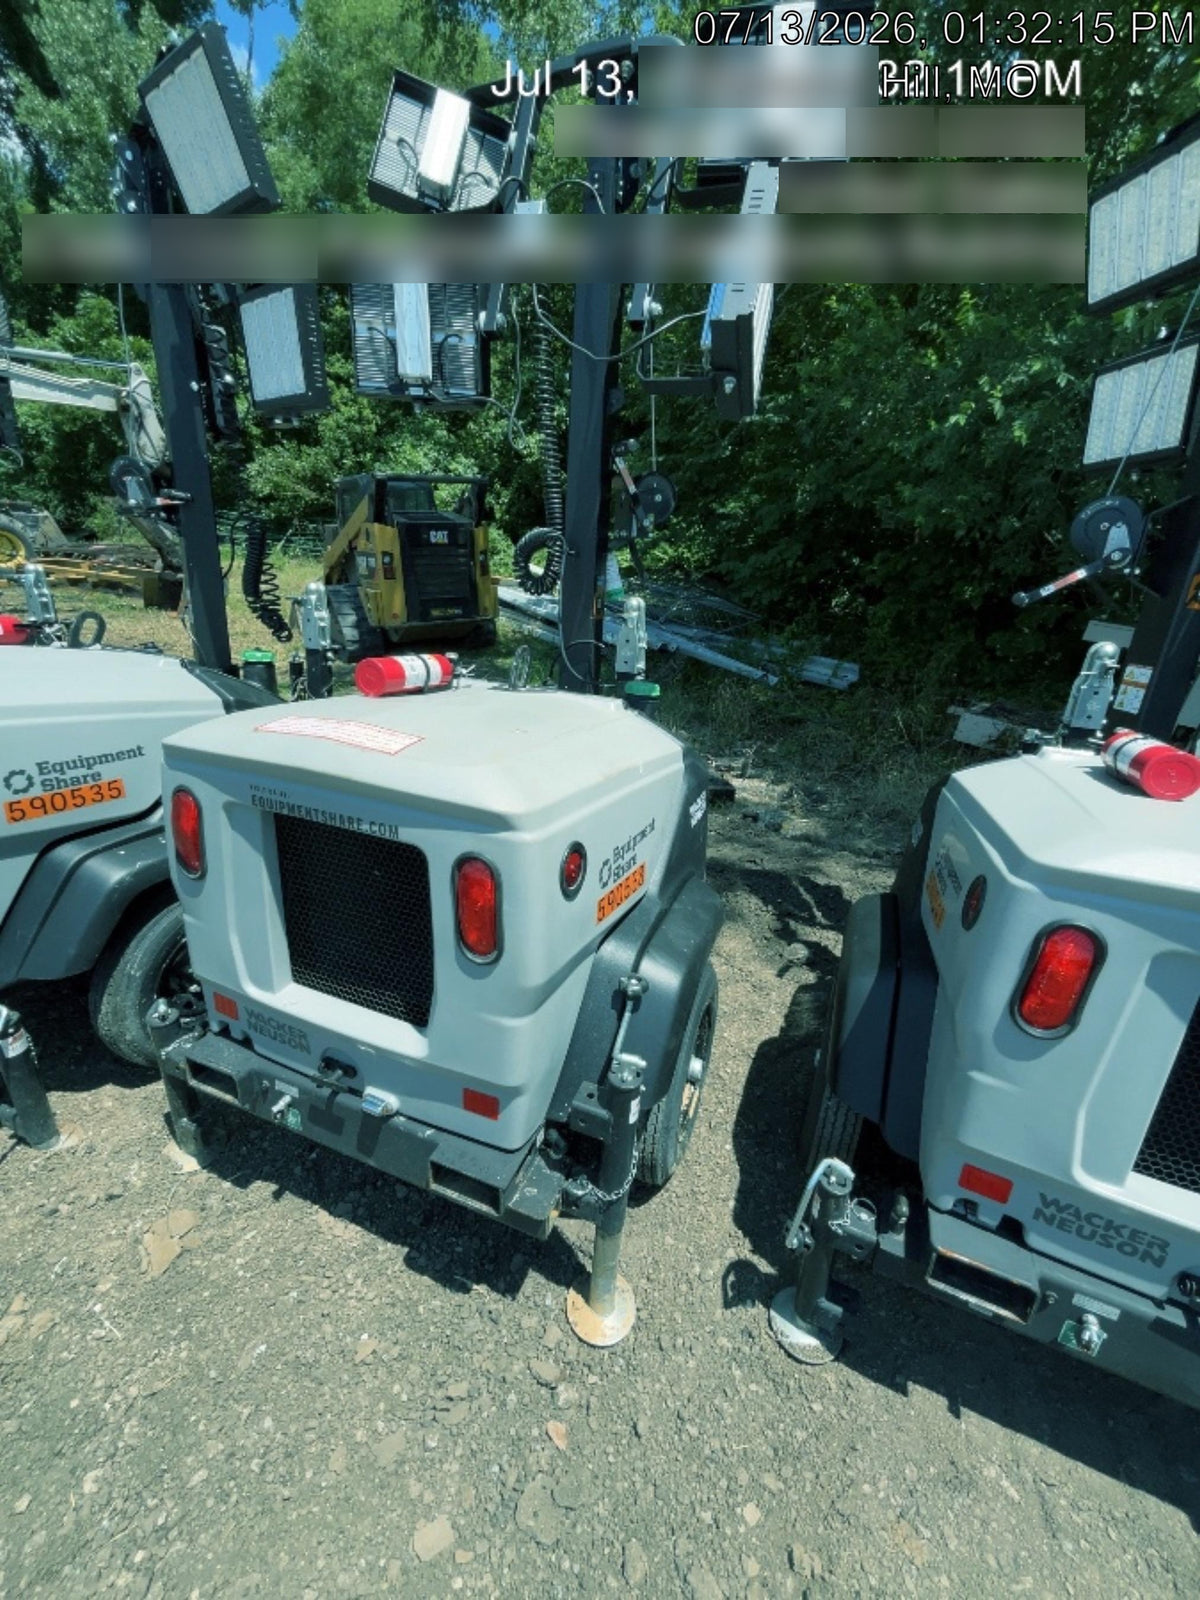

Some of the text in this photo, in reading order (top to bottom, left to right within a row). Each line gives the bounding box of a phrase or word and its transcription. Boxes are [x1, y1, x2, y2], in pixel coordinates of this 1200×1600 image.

[429, 530, 449, 545] CAT
[35, 745, 146, 776] Equipment
[40, 770, 102, 793] Share
[8, 779, 122, 822] 590535
[251, 794, 400, 840] EQUIPMENTSHARE.COM
[244, 1006, 309, 1041] WACKER
[246, 1018, 312, 1055] NEUSON
[1032, 1206, 1169, 1269] NEUSON
[1039, 1191, 1171, 1251] WACKER
